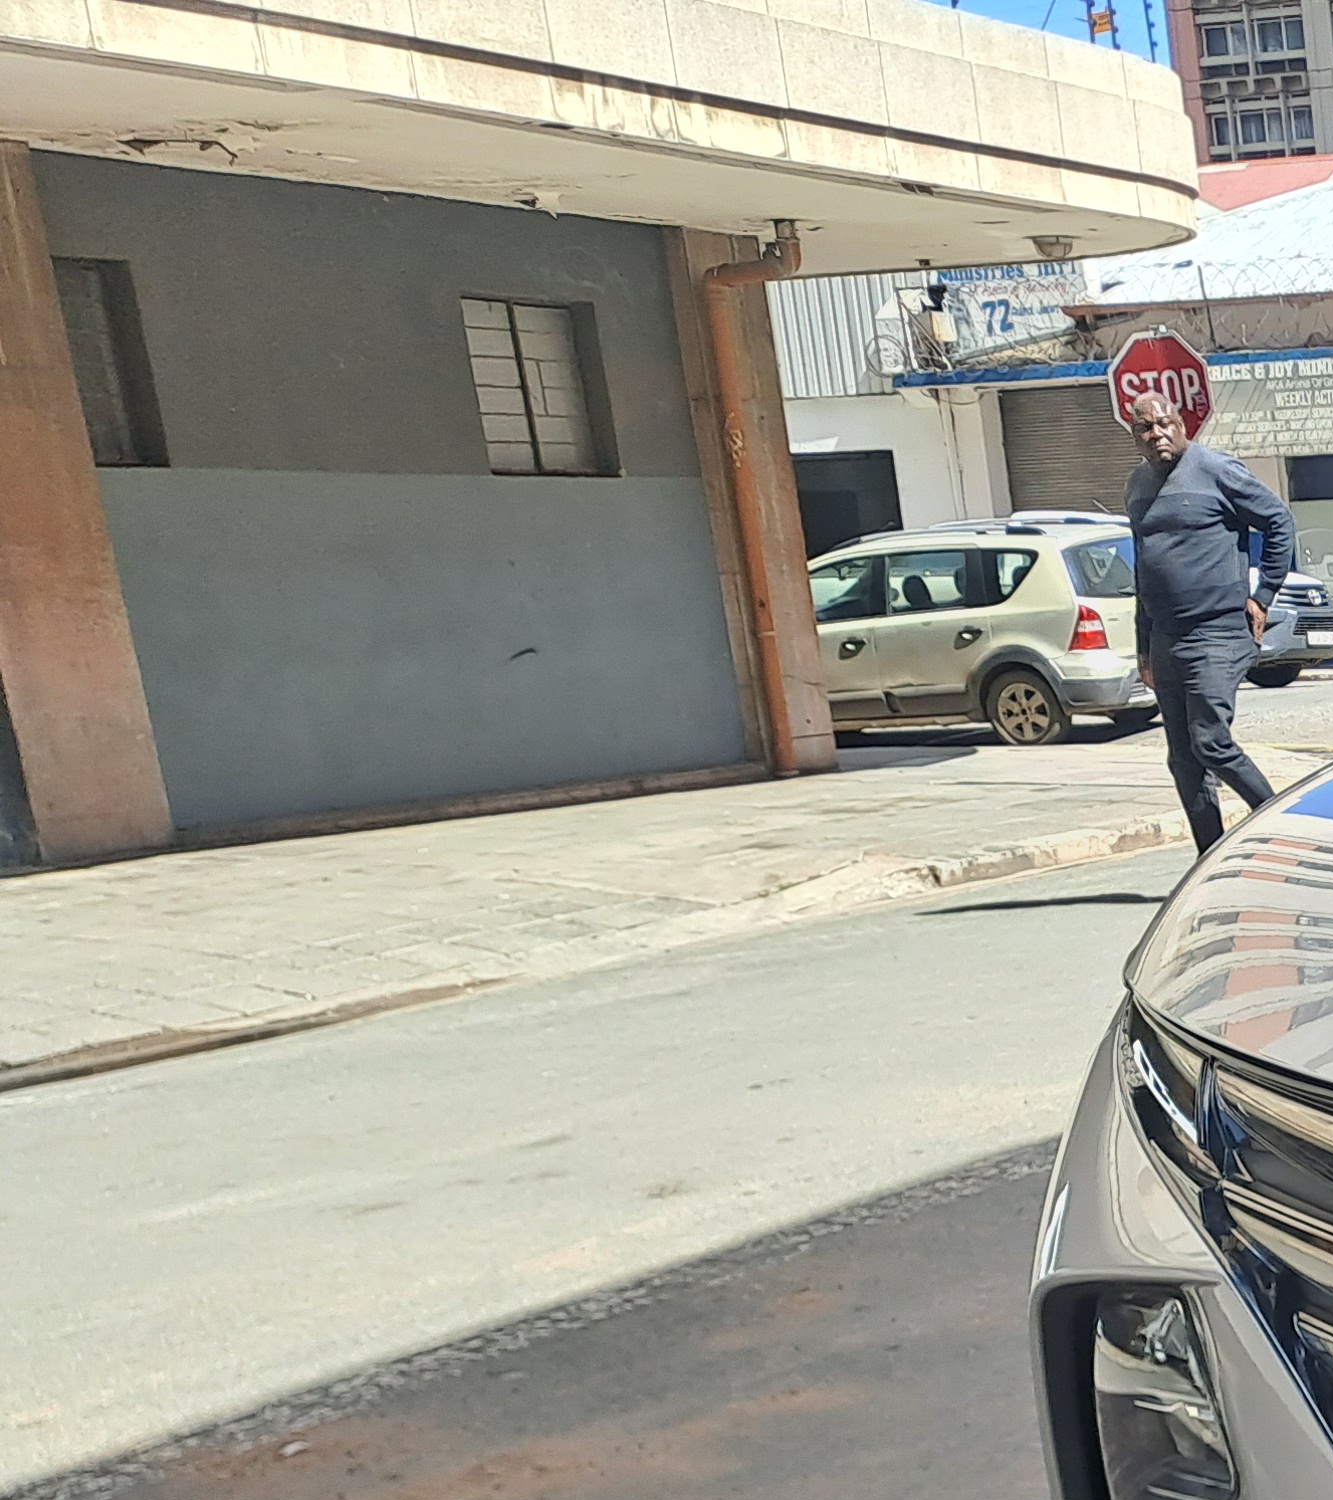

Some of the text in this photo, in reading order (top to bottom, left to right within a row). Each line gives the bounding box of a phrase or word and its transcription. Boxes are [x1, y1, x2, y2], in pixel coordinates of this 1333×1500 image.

[982, 298, 1015, 337] 72
[1269, 360, 1294, 379] JOY
[1121, 367, 1201, 415] STOP
[1275, 390, 1313, 408] WEEKLY
